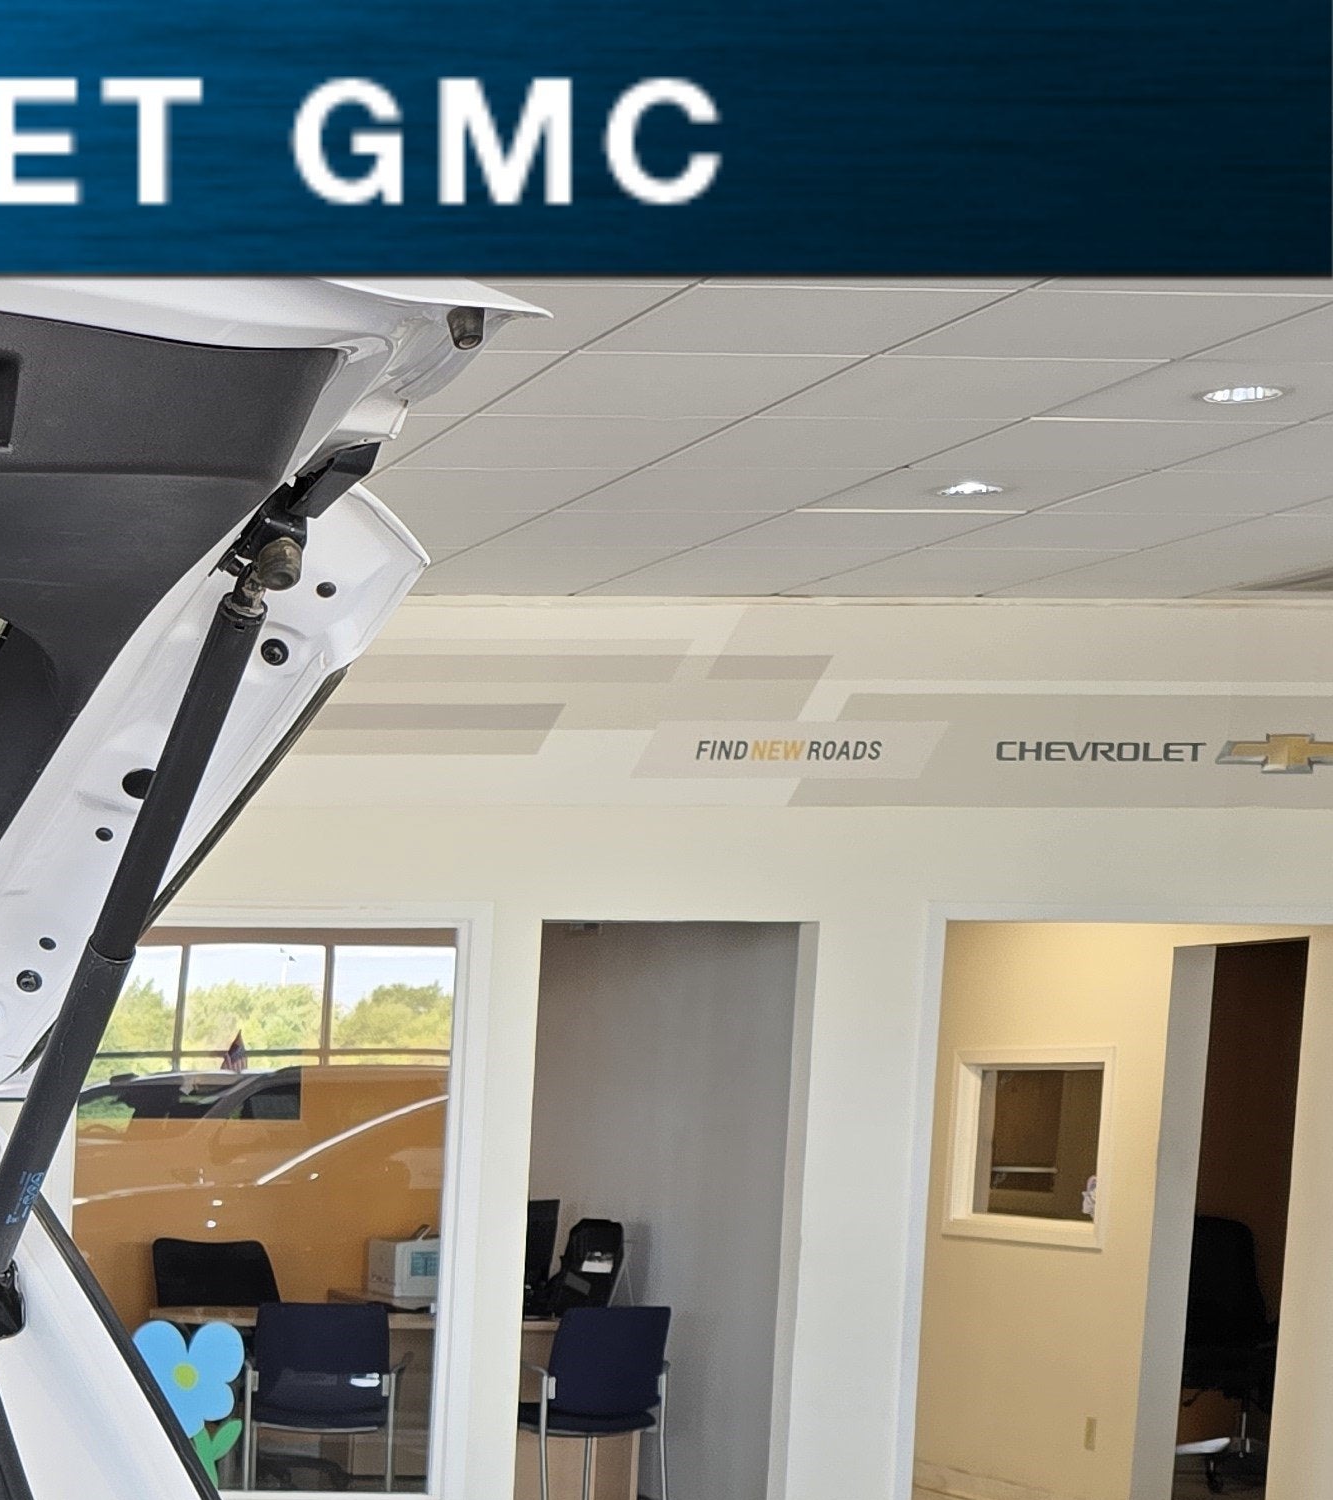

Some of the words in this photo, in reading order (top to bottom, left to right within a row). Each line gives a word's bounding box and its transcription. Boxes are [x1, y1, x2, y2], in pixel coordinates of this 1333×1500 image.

[696, 740, 748, 761] FIND
[750, 740, 806, 761] NEW
[806, 740, 883, 761] ROADS
[996, 741, 1207, 762] CHEVROLET
